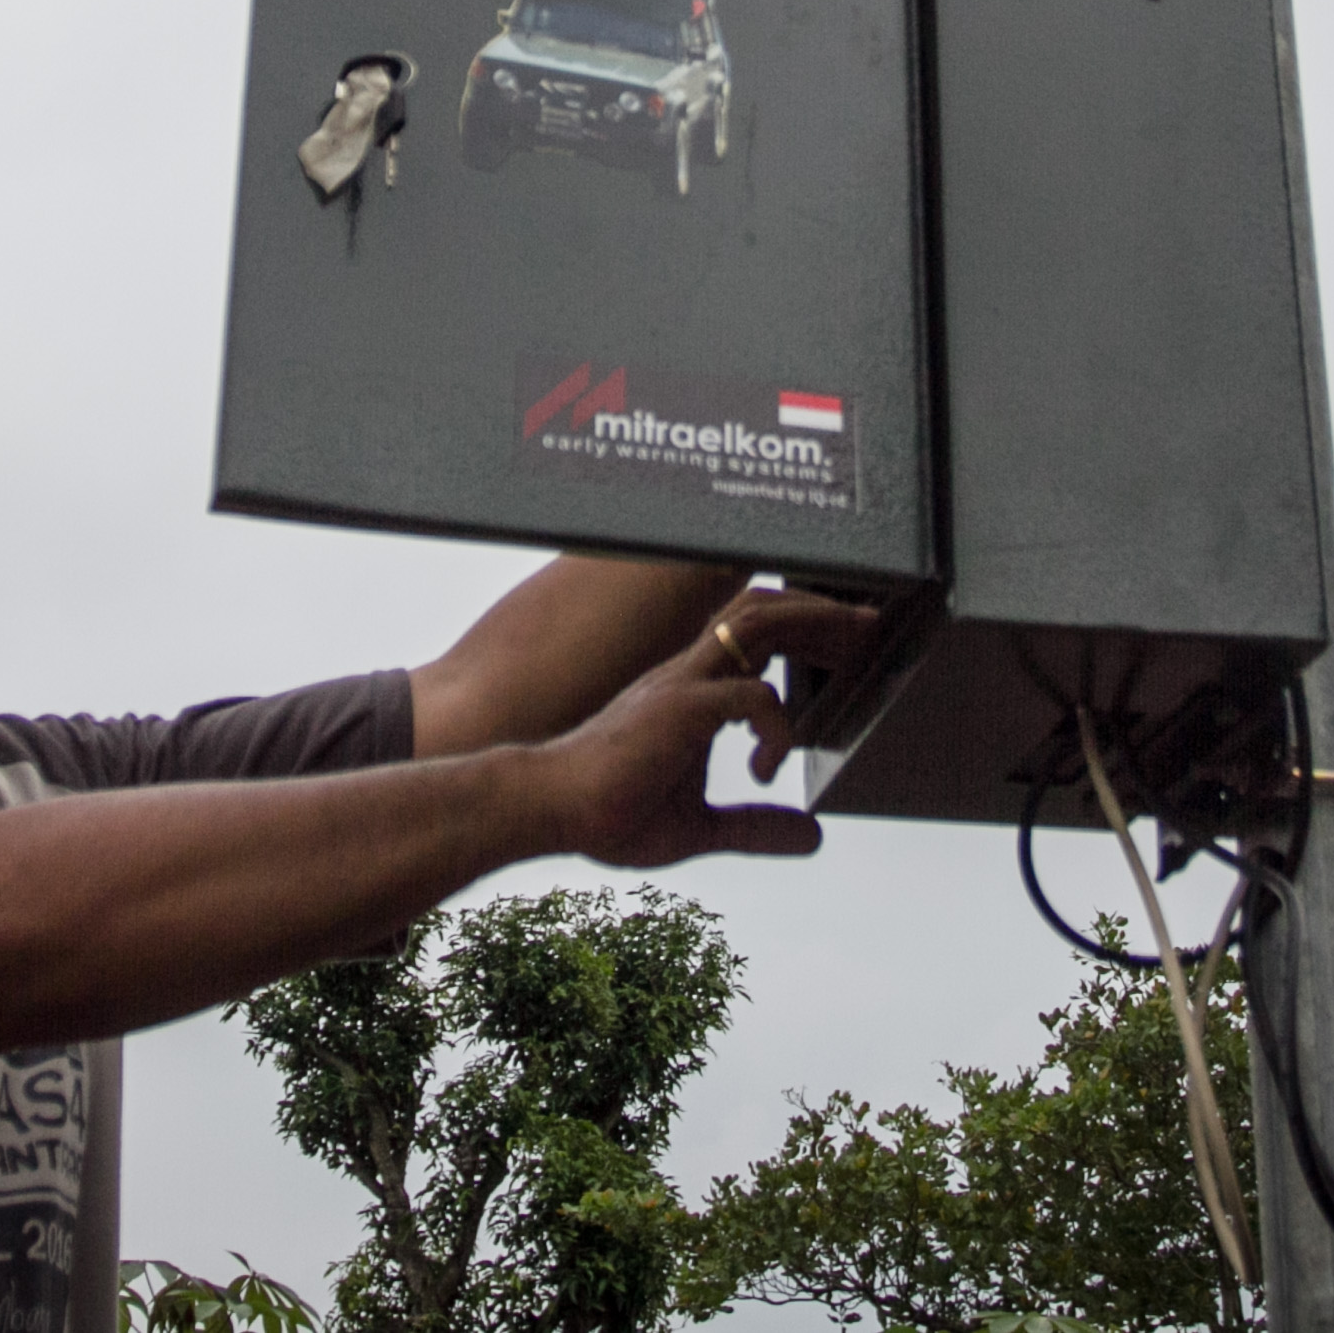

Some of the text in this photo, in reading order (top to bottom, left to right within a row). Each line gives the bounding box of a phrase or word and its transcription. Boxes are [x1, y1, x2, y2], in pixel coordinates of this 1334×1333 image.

[542, 433, 834, 484] early warning systems
